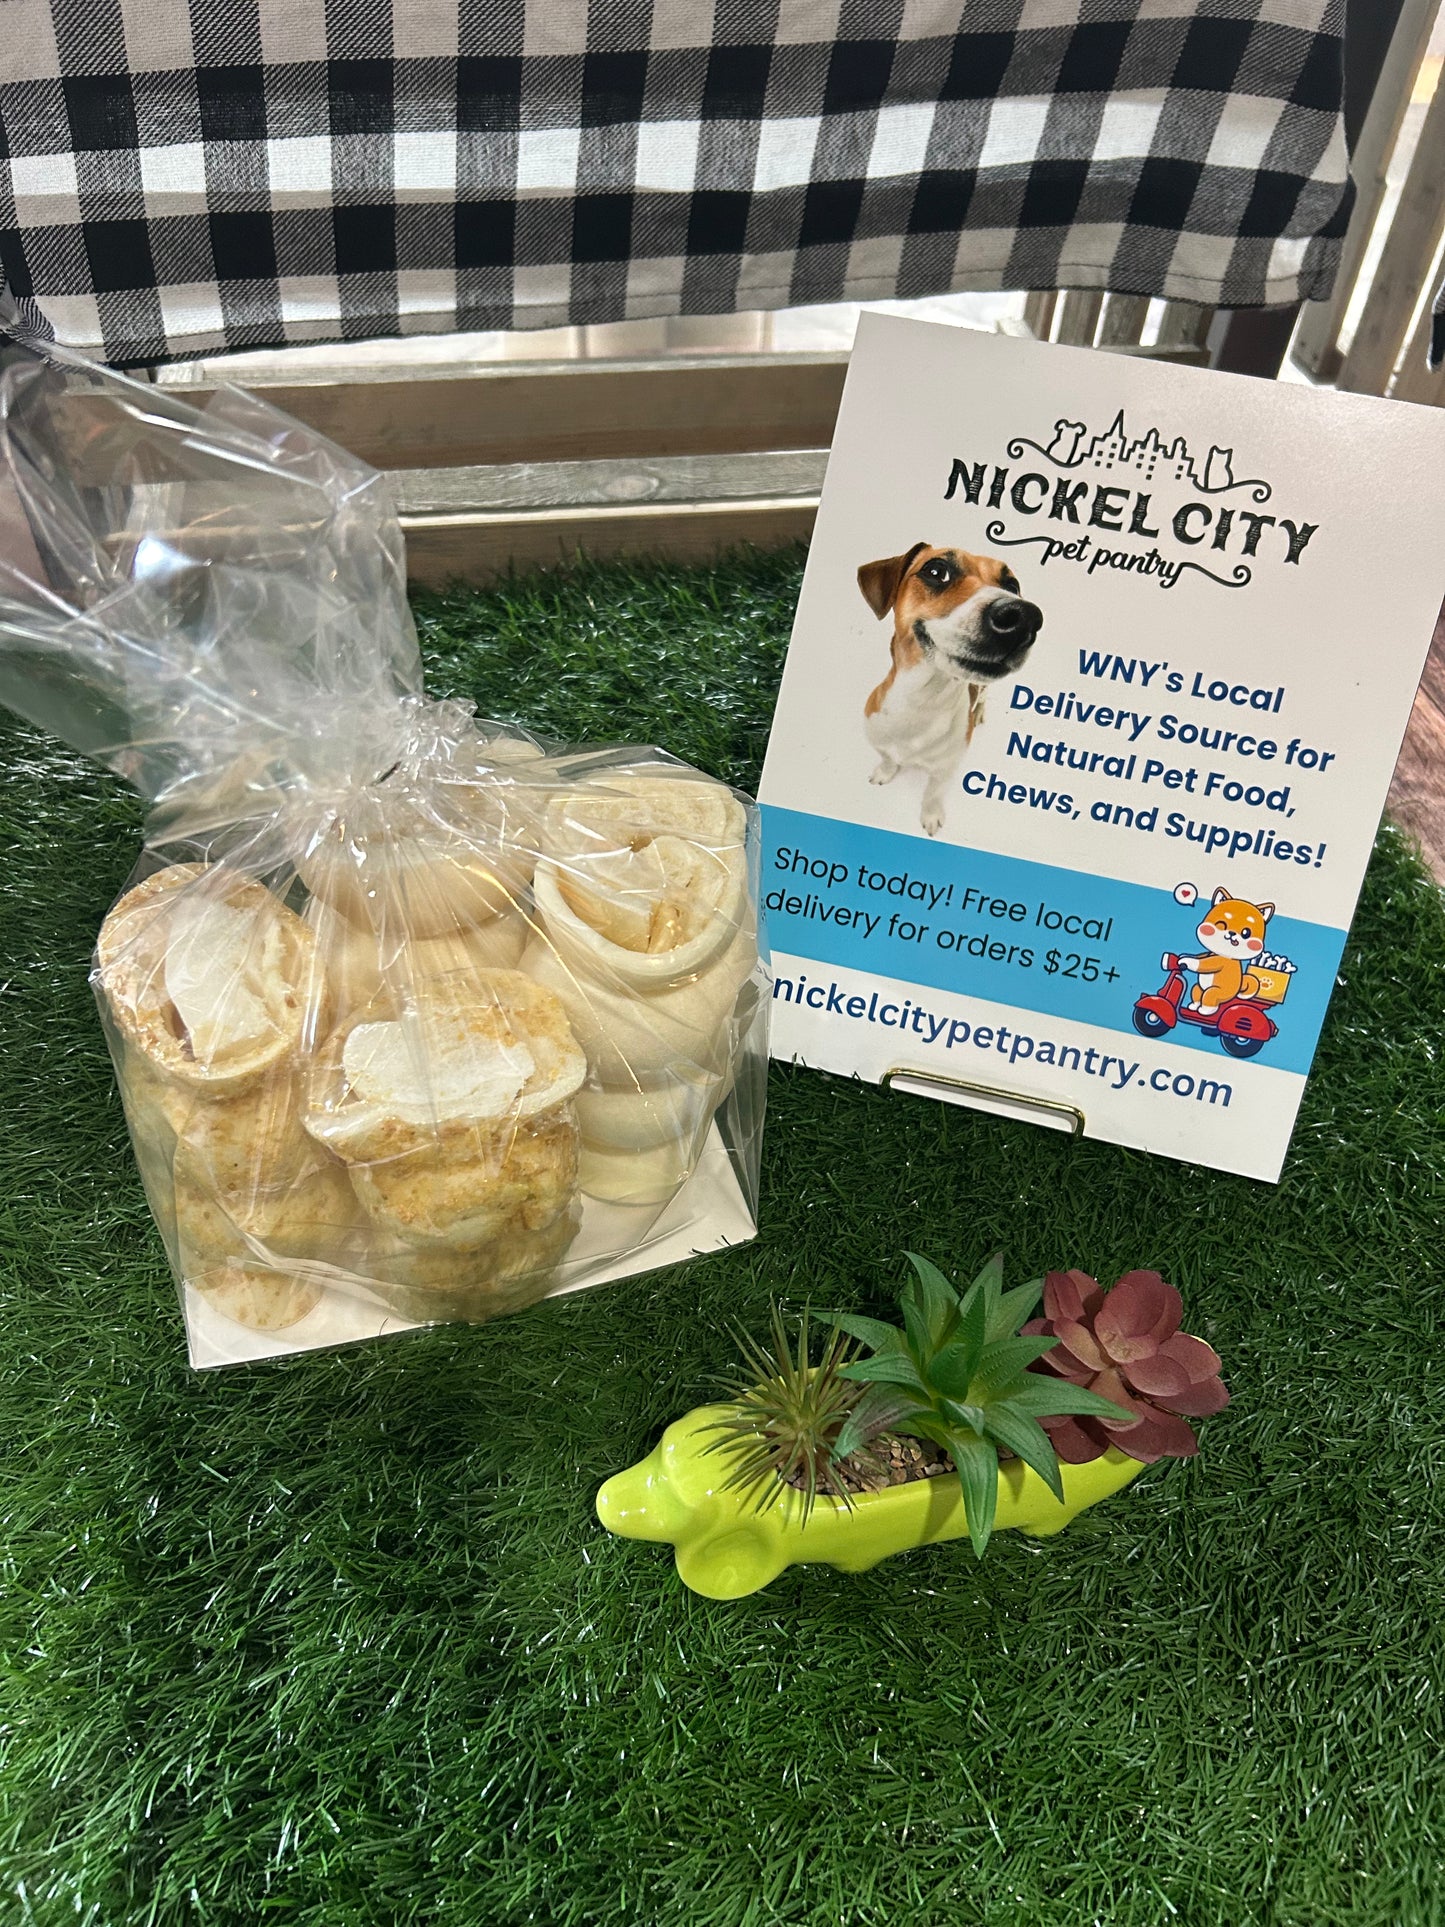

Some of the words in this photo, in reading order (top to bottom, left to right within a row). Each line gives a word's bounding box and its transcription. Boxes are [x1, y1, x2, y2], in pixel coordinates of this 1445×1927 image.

[944, 458, 1161, 536] NICKEL
[1171, 502, 1319, 565] CITY
[1040, 533, 1089, 566] pet
[1088, 546, 1184, 589] pantry
[1010, 684, 1152, 742] Delivery
[1156, 715, 1277, 761] Source
[1284, 738, 1335, 772] for
[1078, 648, 1184, 694] WNY's
[1191, 671, 1285, 714] Local
[962, 770, 1081, 820] Chews,
[1090, 797, 1159, 832] and
[1164, 811, 1326, 868] Supplies!
[1007, 732, 1135, 781] Natural
[1141, 758, 1198, 793] Pet
[1204, 772, 1297, 818] Food,
[766, 888, 880, 938] delivery
[888, 914, 929, 943] for
[936, 928, 1035, 968] orders
[1043, 949, 1122, 985] $25+
[774, 846, 850, 889] Shop
[858, 863, 954, 907] today!
[962, 887, 1028, 922] Free
[1036, 902, 1114, 942] local
[772, 974, 1233, 1107] nickelcitypetpantry.com
